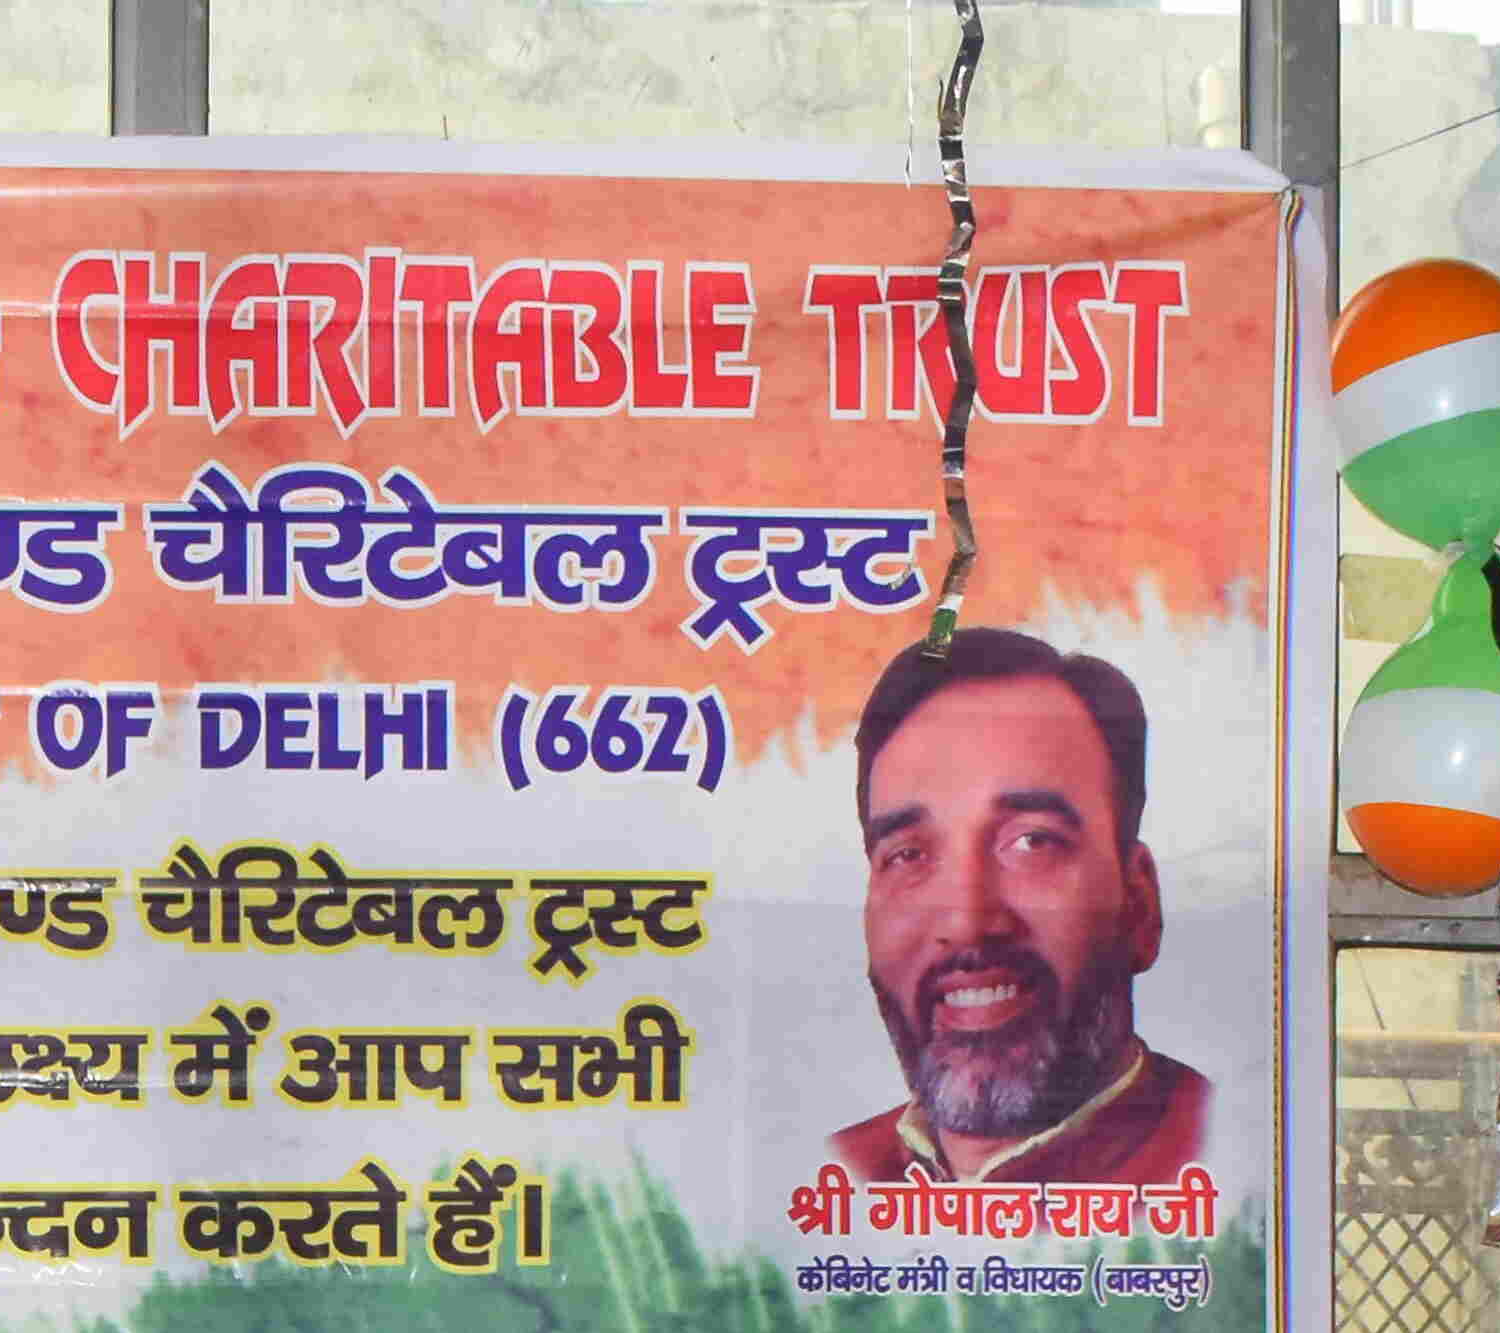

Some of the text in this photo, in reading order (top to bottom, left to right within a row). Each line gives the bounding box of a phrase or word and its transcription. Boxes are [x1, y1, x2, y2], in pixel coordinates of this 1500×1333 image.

[54, 248, 760, 436] CHARITABLE
[804, 262, 1190, 440] TRUST
[148, 464, 662, 608] चैरिटेबल
[686, 506, 932, 646] ट्रस्ट
[36, 690, 154, 778] OF
[196, 688, 450, 780] DELHI
[500, 688, 726, 793] (662)
[140, 844, 513, 949] चैरिटेबल
[530, 878, 708, 978] ट्रस्ट
[171, 1005, 271, 1102] में
[281, 1033, 470, 1102] आप
[495, 1003, 689, 1103] सभी
[180, 1163, 407, 1260] करते
[787, 1164, 1219, 1239] श्री गोपाल राय जी
[896, 1254, 950, 1292] मंत्री
[955, 1265, 977, 1292] व
[983, 1254, 1085, 1293] विधायक
[1094, 1256, 1210, 1307] (बाबरपुर)
